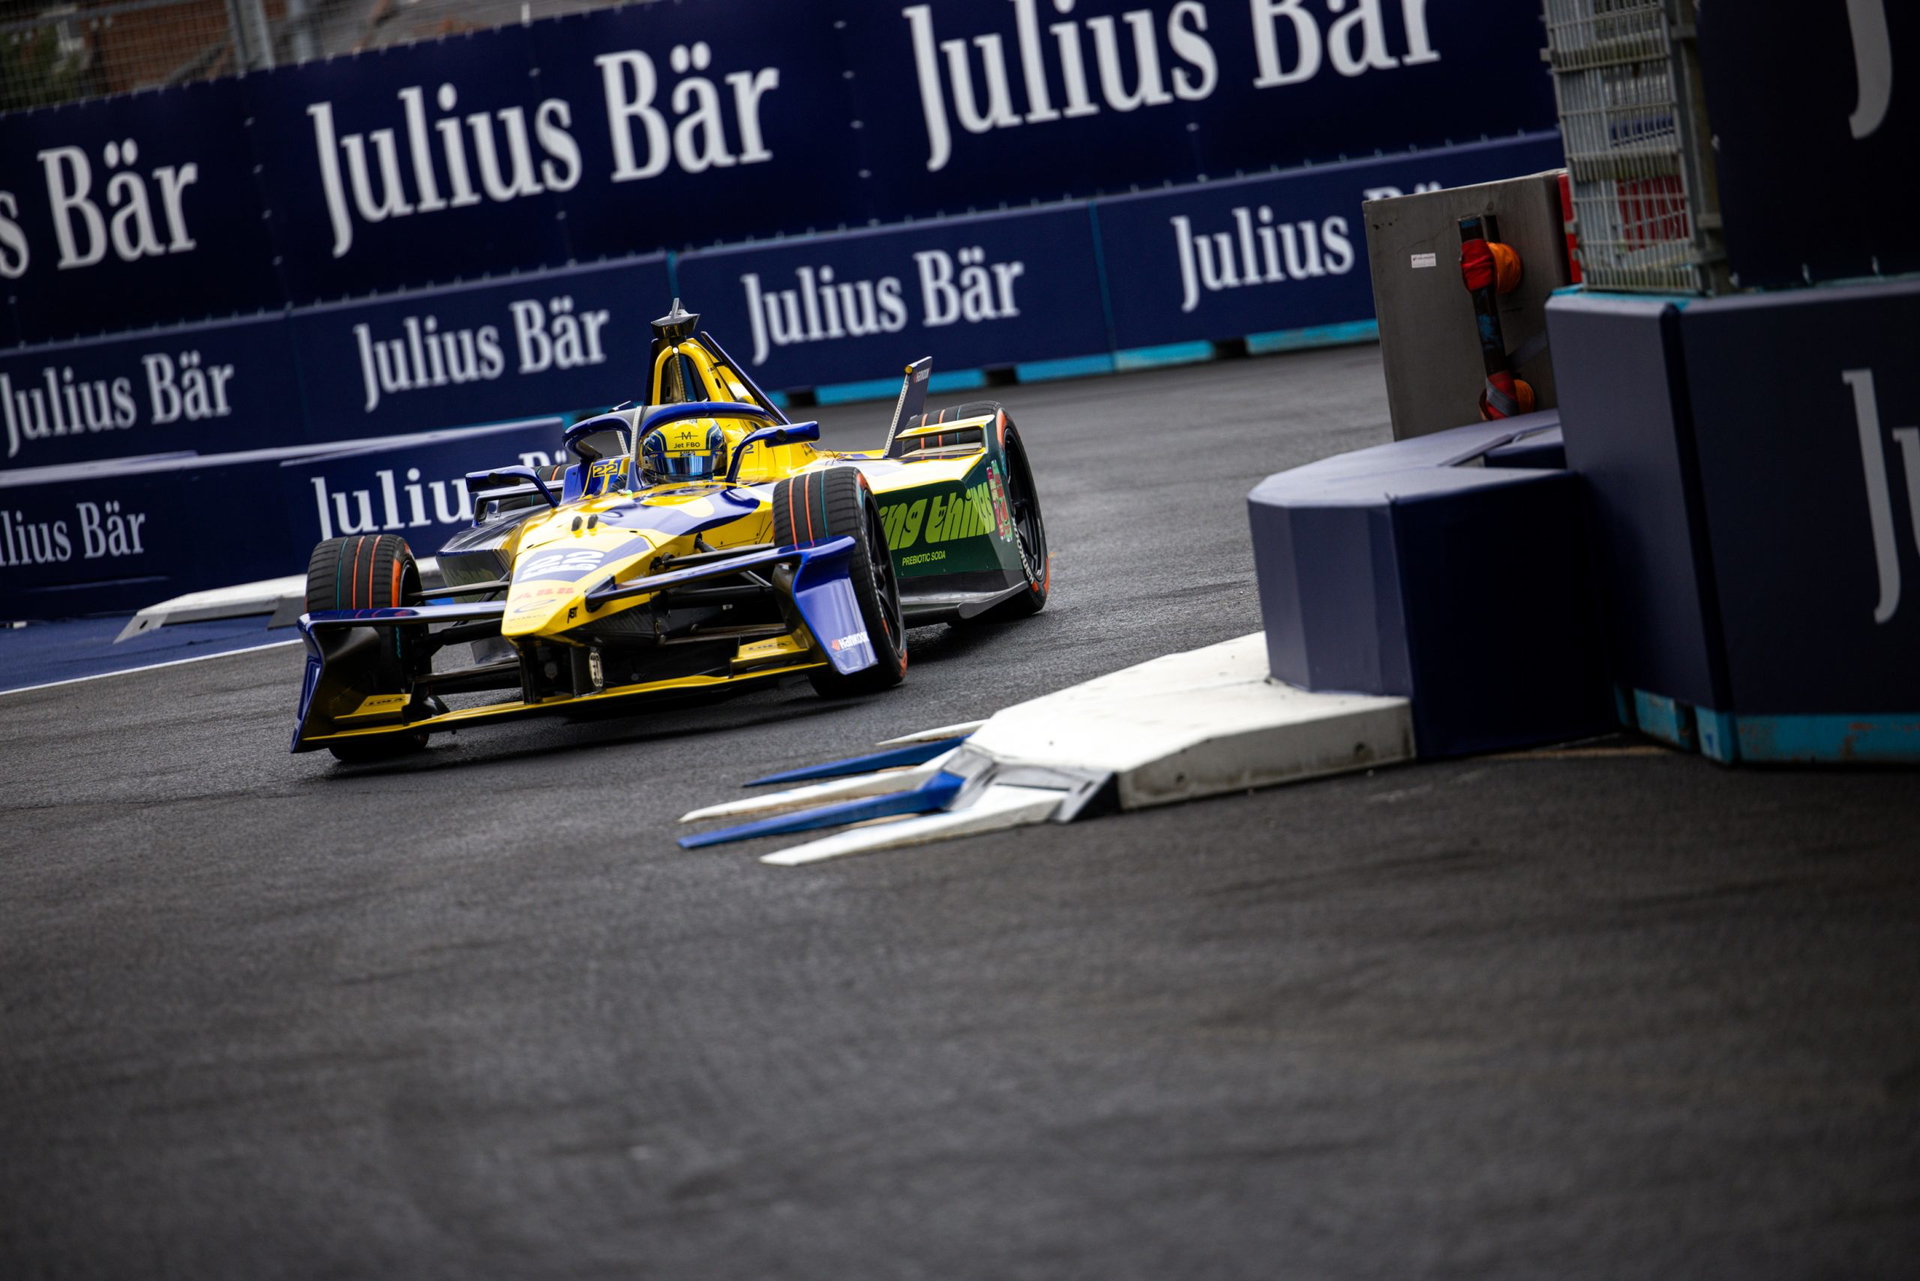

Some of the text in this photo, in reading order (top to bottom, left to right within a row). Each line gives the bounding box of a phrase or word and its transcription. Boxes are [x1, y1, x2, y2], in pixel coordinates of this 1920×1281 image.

[902, 0, 1218, 171] Julius
[306, 41, 780, 258] Julius Bär
[36, 138, 198, 271] Bär
[741, 246, 1025, 366] Julius Bär
[1170, 205, 1356, 313] Julius
[0, 350, 235, 458] Julius Bär
[354, 295, 611, 412] Julius Bär
[310, 467, 474, 543] Juliu
[593, 464, 617, 476] 22
[924, 482, 995, 544] things
[0, 500, 146, 567] lius Bär
[901, 550, 946, 566] PREBIOTIC SODA
